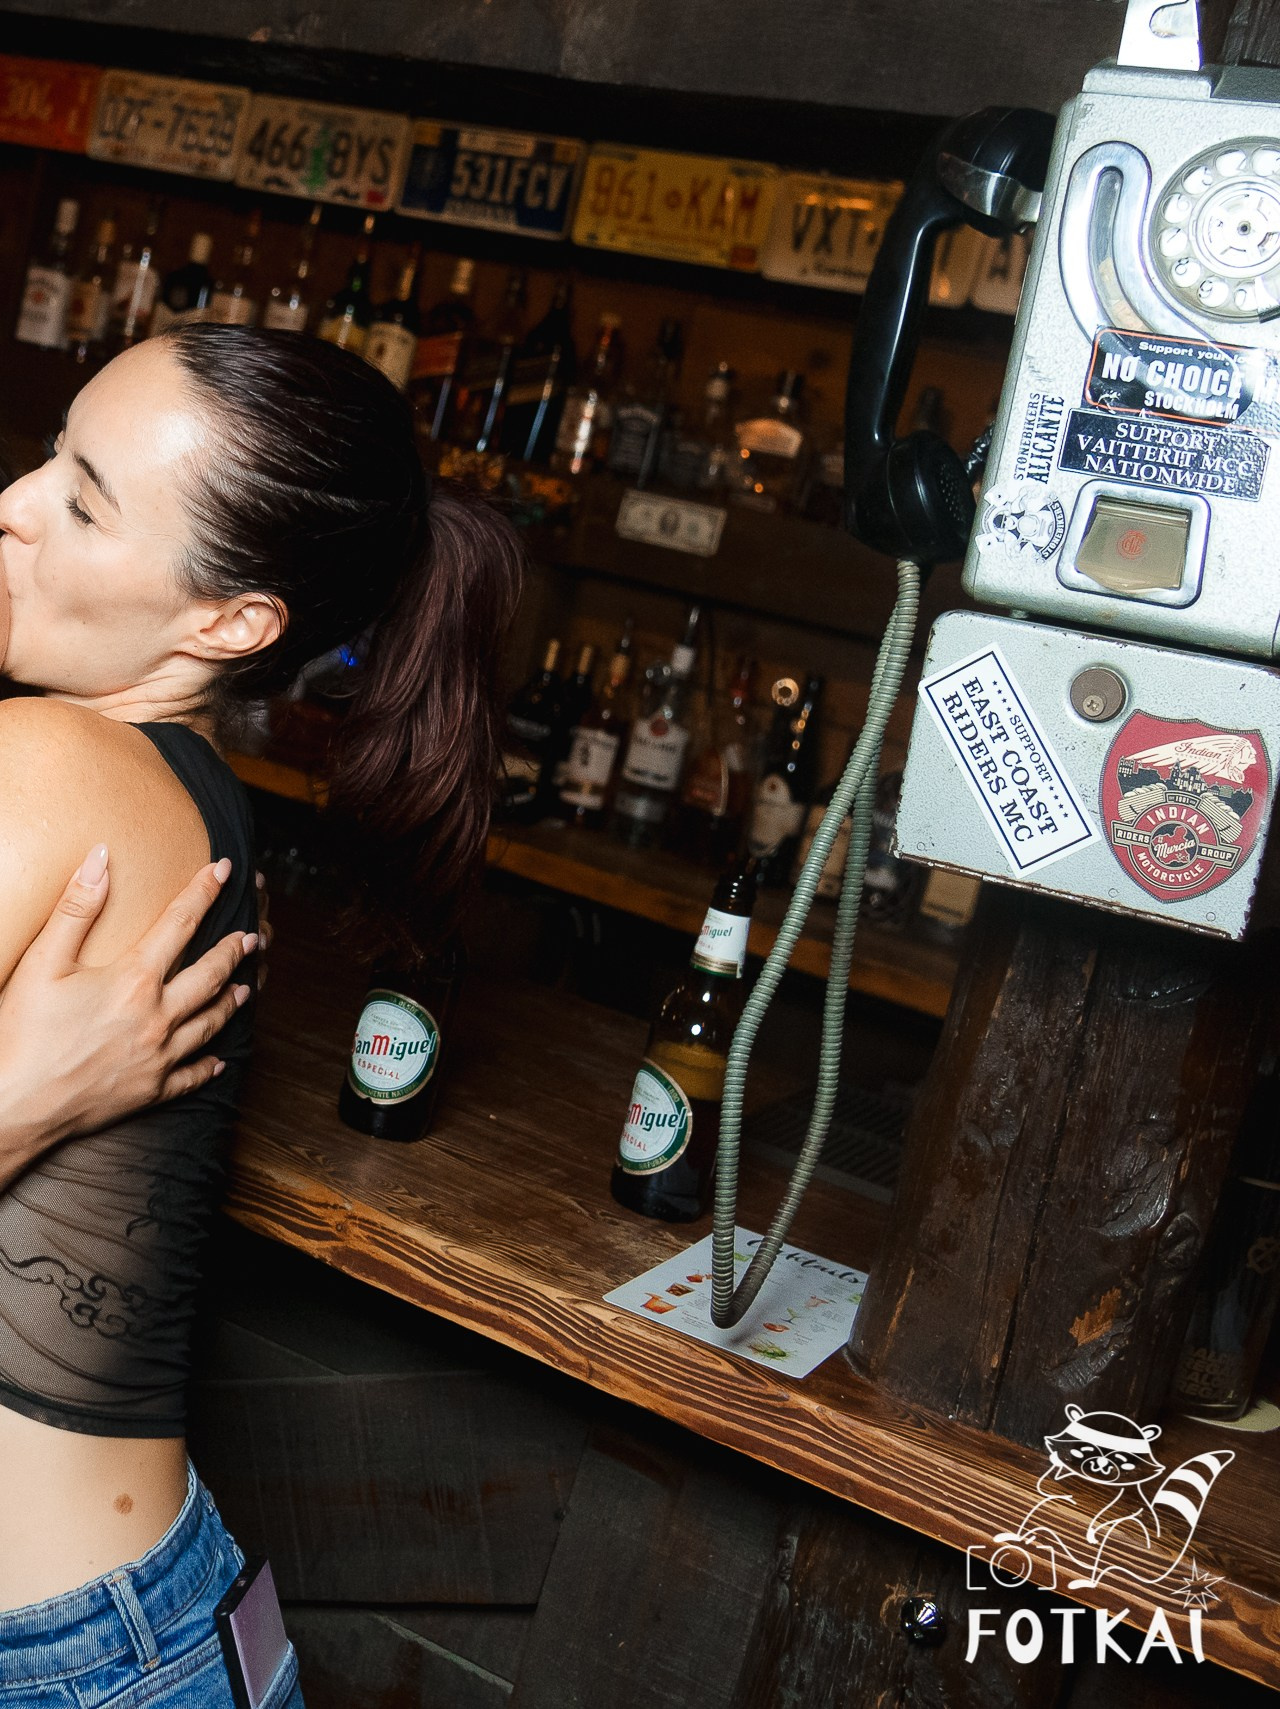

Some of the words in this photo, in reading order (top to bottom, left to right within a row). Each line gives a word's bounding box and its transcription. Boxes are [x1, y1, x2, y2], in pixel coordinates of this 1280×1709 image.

[247, 117, 310, 171] 466
[1174, 257, 1190, 276] 8
[1138, 341, 1194, 357] Support
[1146, 360, 1244, 400] CHOICE
[1144, 390, 1240, 420] STOCKHOLM
[1013, 392, 1041, 481] STONEBIKERS
[1026, 394, 1065, 485] ALICANTE
[1115, 422, 1220, 452] SUPPORT
[1077, 433, 1198, 468] VAITTERIT
[1201, 454, 1254, 479] MCC
[1083, 454, 1238, 494] NATIONWIDE
[962, 676, 1010, 745] EAST
[1002, 749, 1059, 836] COAST
[1009, 714, 1053, 783] SUPPORT
[1175, 742, 1222, 760] Indian
[942, 690, 1008, 796] RIDERS
[999, 798, 1035, 842] MC
[1146, 806, 1210, 836] INDIAN
[1116, 829, 1150, 844] RIDERS
[1201, 846, 1233, 861] GROUP
[1154, 838, 1196, 859] Murcia
[1136, 852, 1205, 883] MOTORCYCLE
[702, 925, 733, 939] Miguel
[357, 1058, 400, 1080] ESPECIAL
[627, 1103, 688, 1132] Miguel
